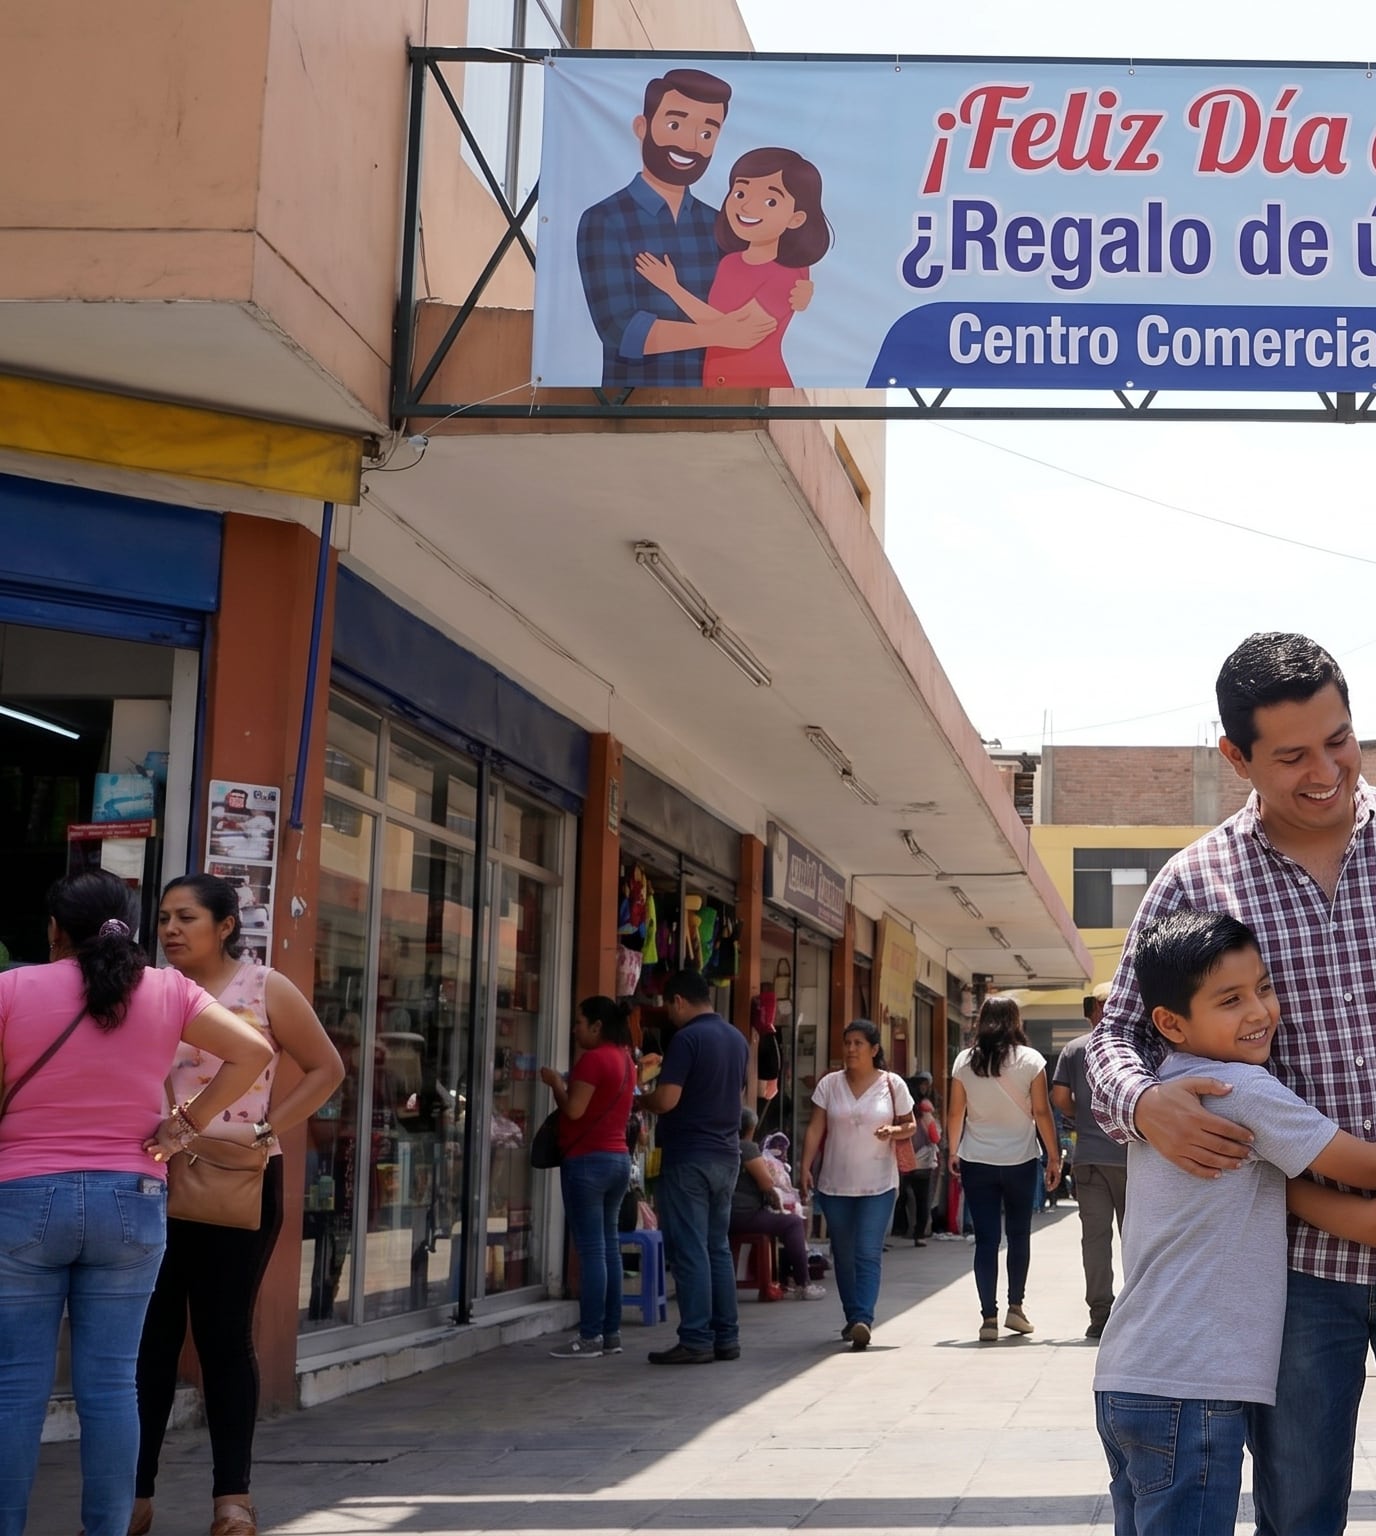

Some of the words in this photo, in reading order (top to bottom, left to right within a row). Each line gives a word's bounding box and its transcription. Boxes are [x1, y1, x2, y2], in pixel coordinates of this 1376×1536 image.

[923, 86, 1163, 193] ¡Feliz
[1189, 89, 1348, 174] Día
[902, 200, 1212, 290] ¿Regalo
[1239, 204, 1329, 276] de
[949, 312, 1119, 365] Centro
